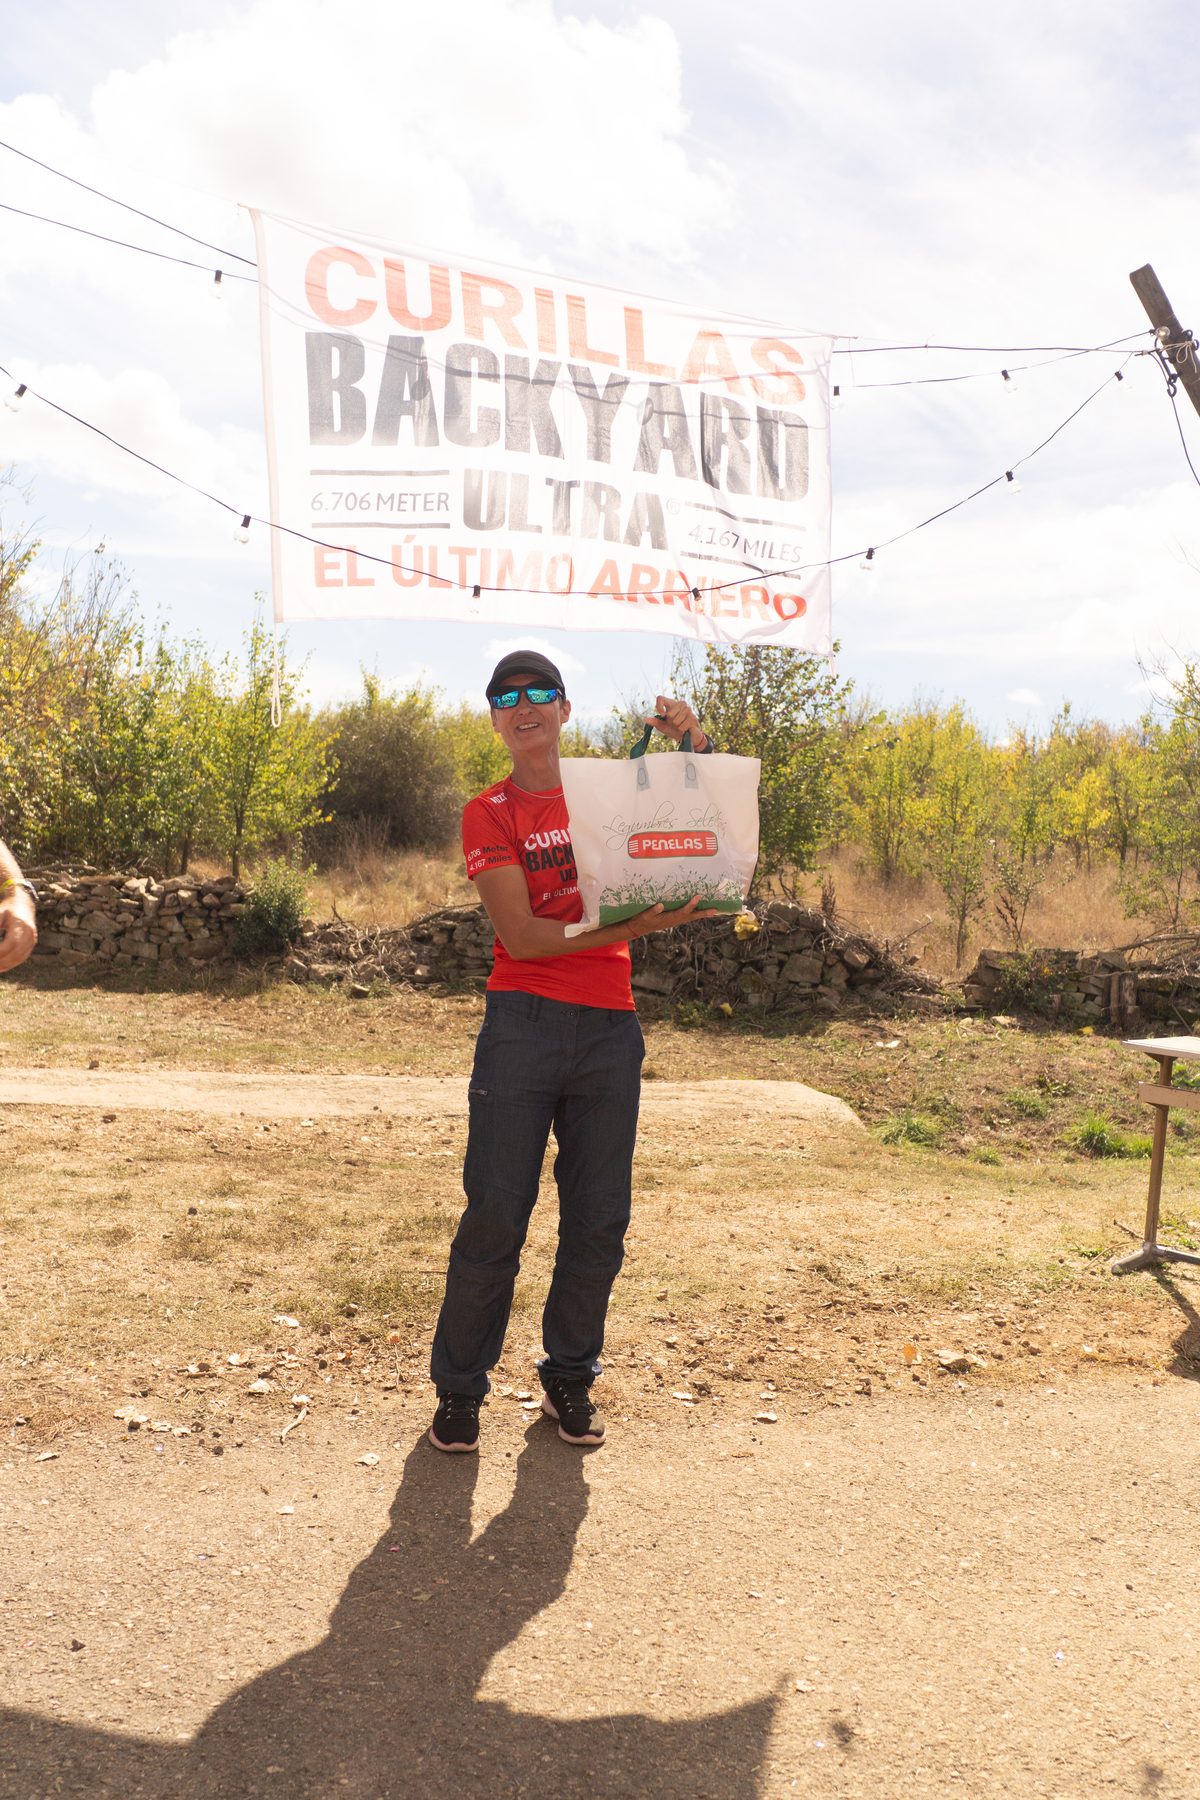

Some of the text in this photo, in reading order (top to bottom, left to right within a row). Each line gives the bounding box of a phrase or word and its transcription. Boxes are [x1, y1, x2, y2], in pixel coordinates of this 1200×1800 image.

[304, 245, 806, 405] CURILLAS
[303, 331, 809, 502] BACKYARD
[462, 468, 669, 551] ULTRA
[313, 534, 808, 621] EL ÚLTIMO ARRIERO
[524, 828, 571, 850] CURI
[642, 838, 703, 850] PENELAS
